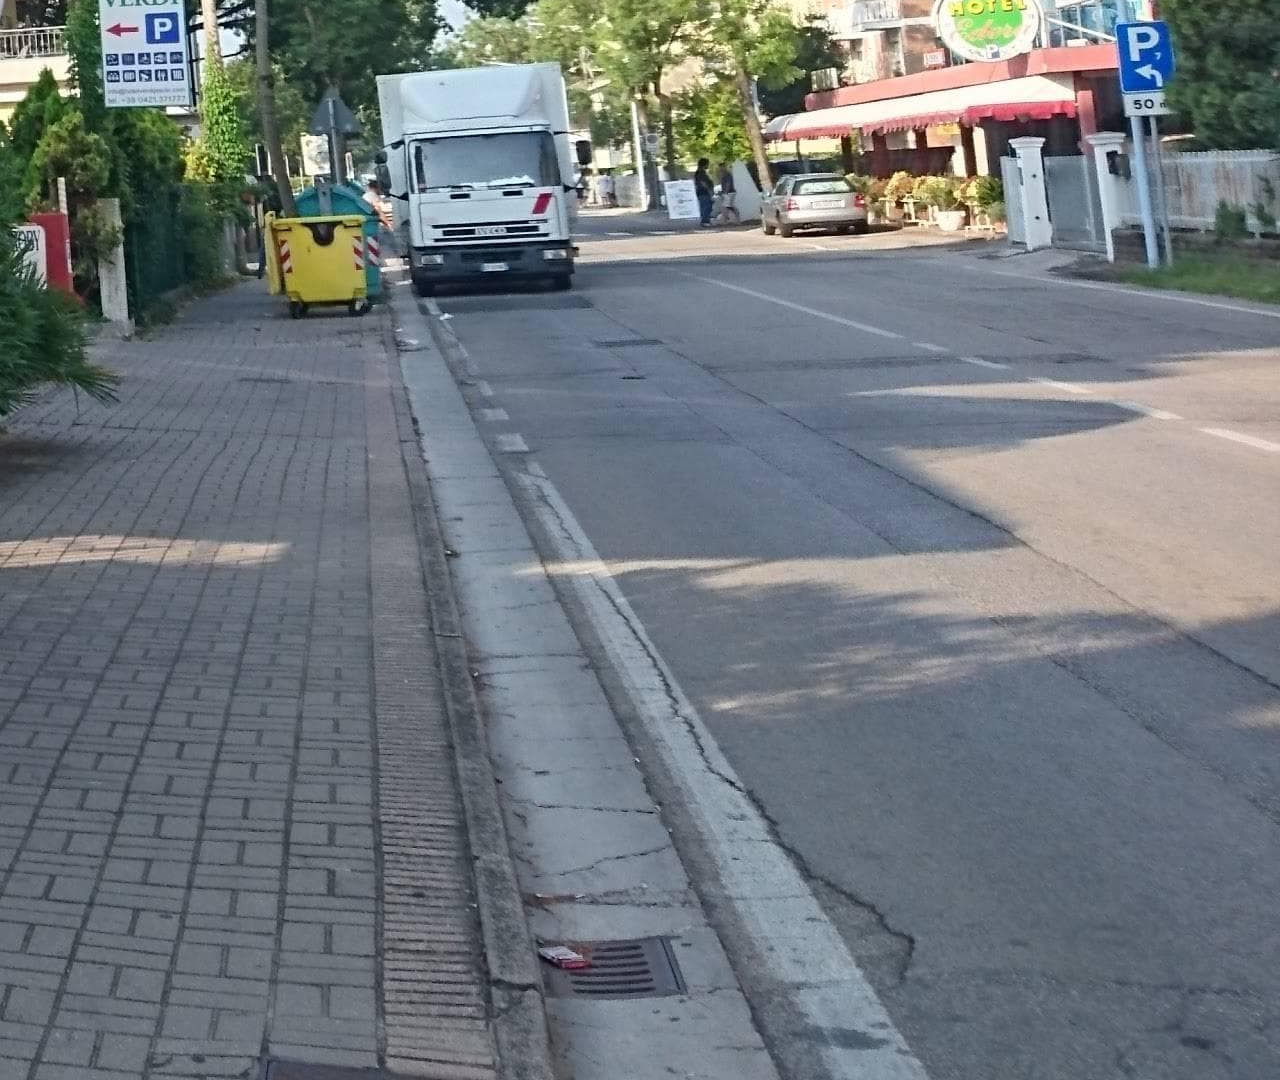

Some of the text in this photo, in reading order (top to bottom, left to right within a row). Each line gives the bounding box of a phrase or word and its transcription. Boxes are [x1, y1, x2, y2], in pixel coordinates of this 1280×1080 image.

[154, 17, 172, 40] P
[1127, 26, 1159, 61] P
[1133, 99, 1154, 109] 50
